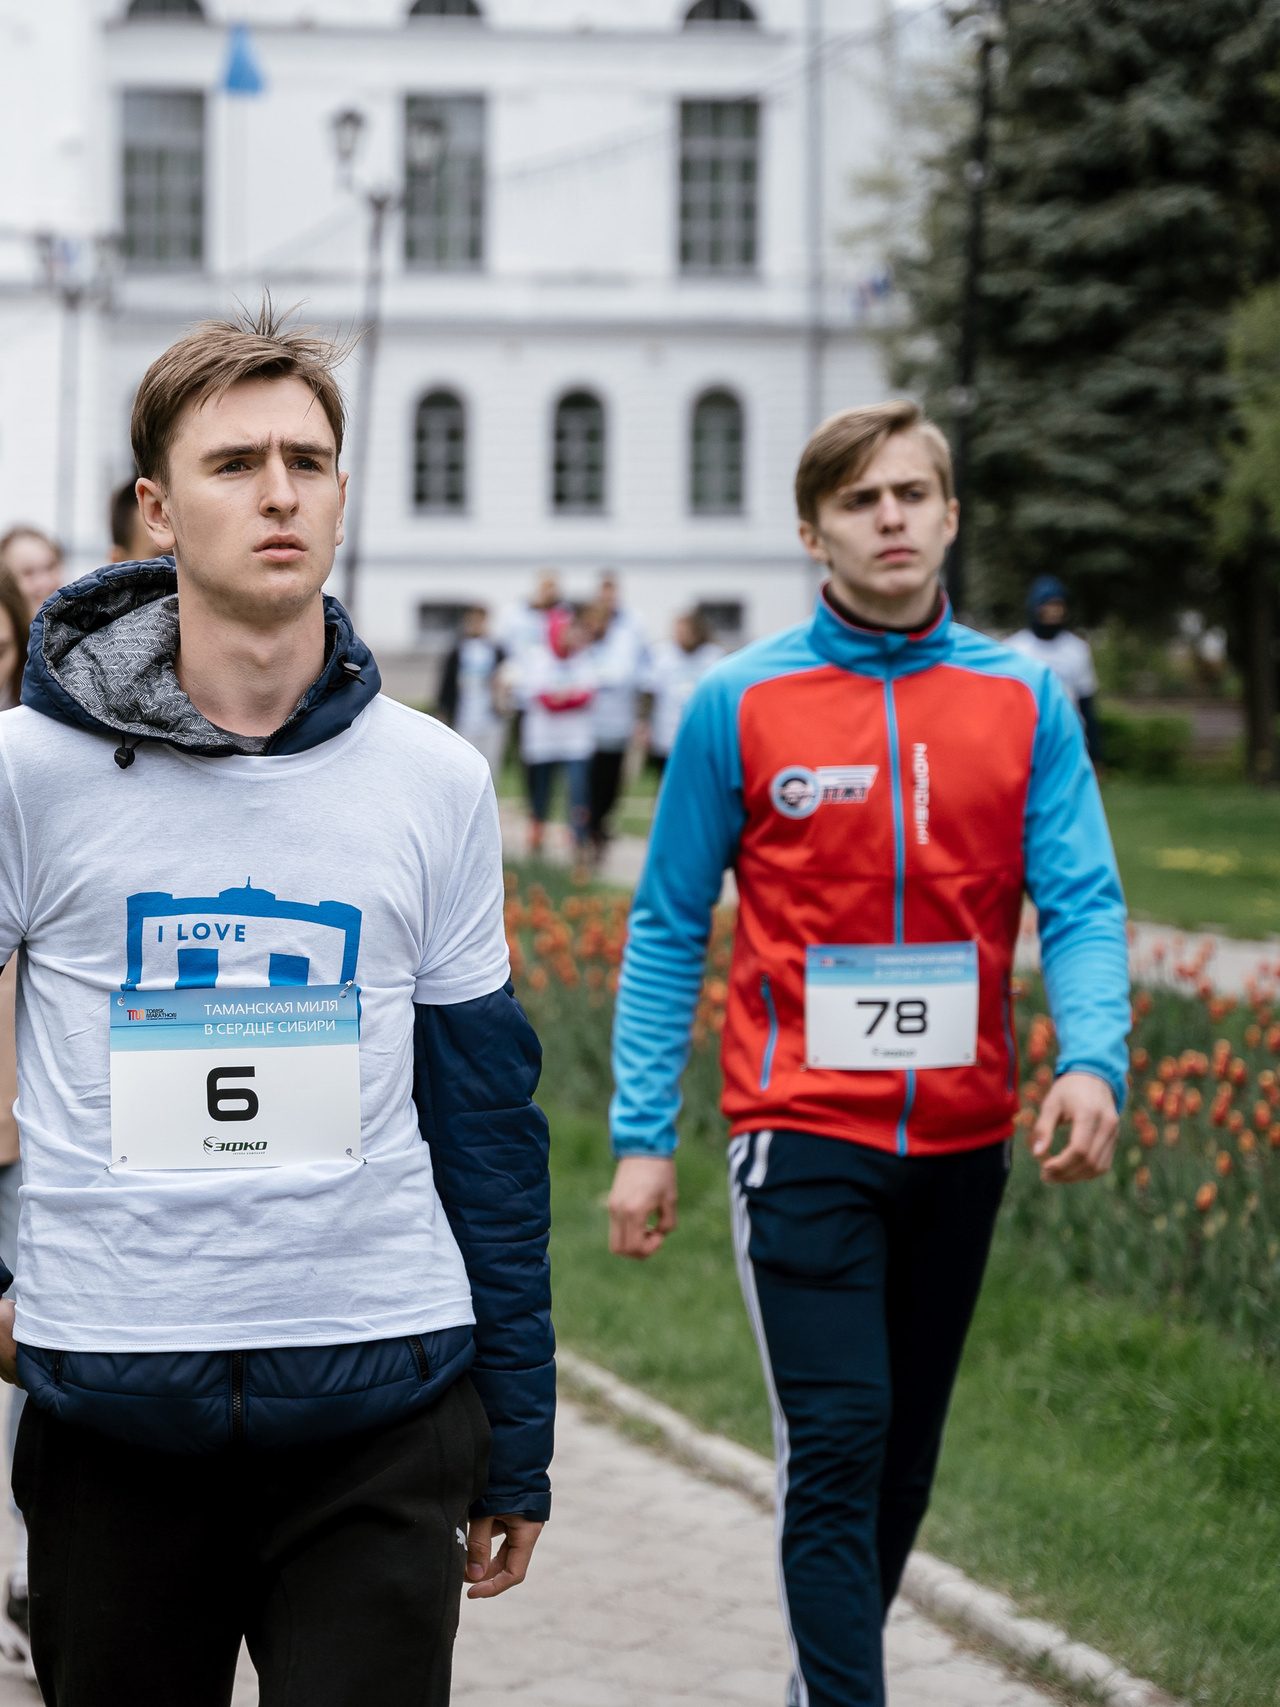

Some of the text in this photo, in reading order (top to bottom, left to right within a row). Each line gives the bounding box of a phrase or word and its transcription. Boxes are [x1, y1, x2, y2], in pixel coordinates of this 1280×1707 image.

[157, 922, 246, 943] I LOVE
[204, 1000, 339, 1016] ТАМАНСКАЯ МИЛЯ
[855, 999, 928, 1036] 78
[204, 1020, 336, 1037] В СЕРДЦЕ СИБИРИ
[206, 1066, 259, 1122] 6
[213, 1141, 268, 1152] ЭФКО
